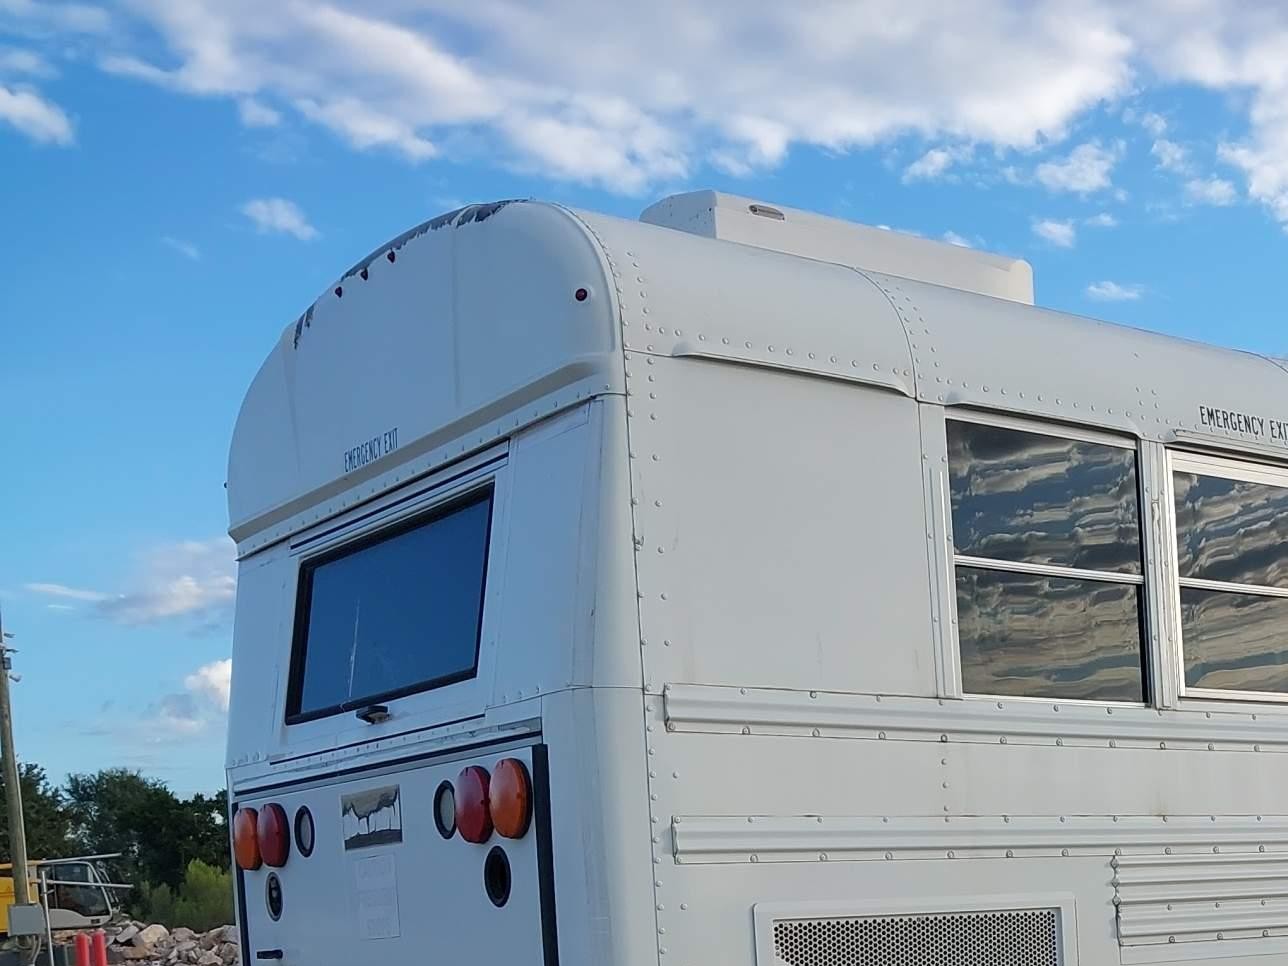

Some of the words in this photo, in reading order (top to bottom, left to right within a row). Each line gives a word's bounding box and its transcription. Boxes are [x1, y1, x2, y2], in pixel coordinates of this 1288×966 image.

[1199, 405, 1265, 437] EMERGENCY
[343, 436, 382, 473] EMERGENCY
[383, 427, 398, 454] EXIT
